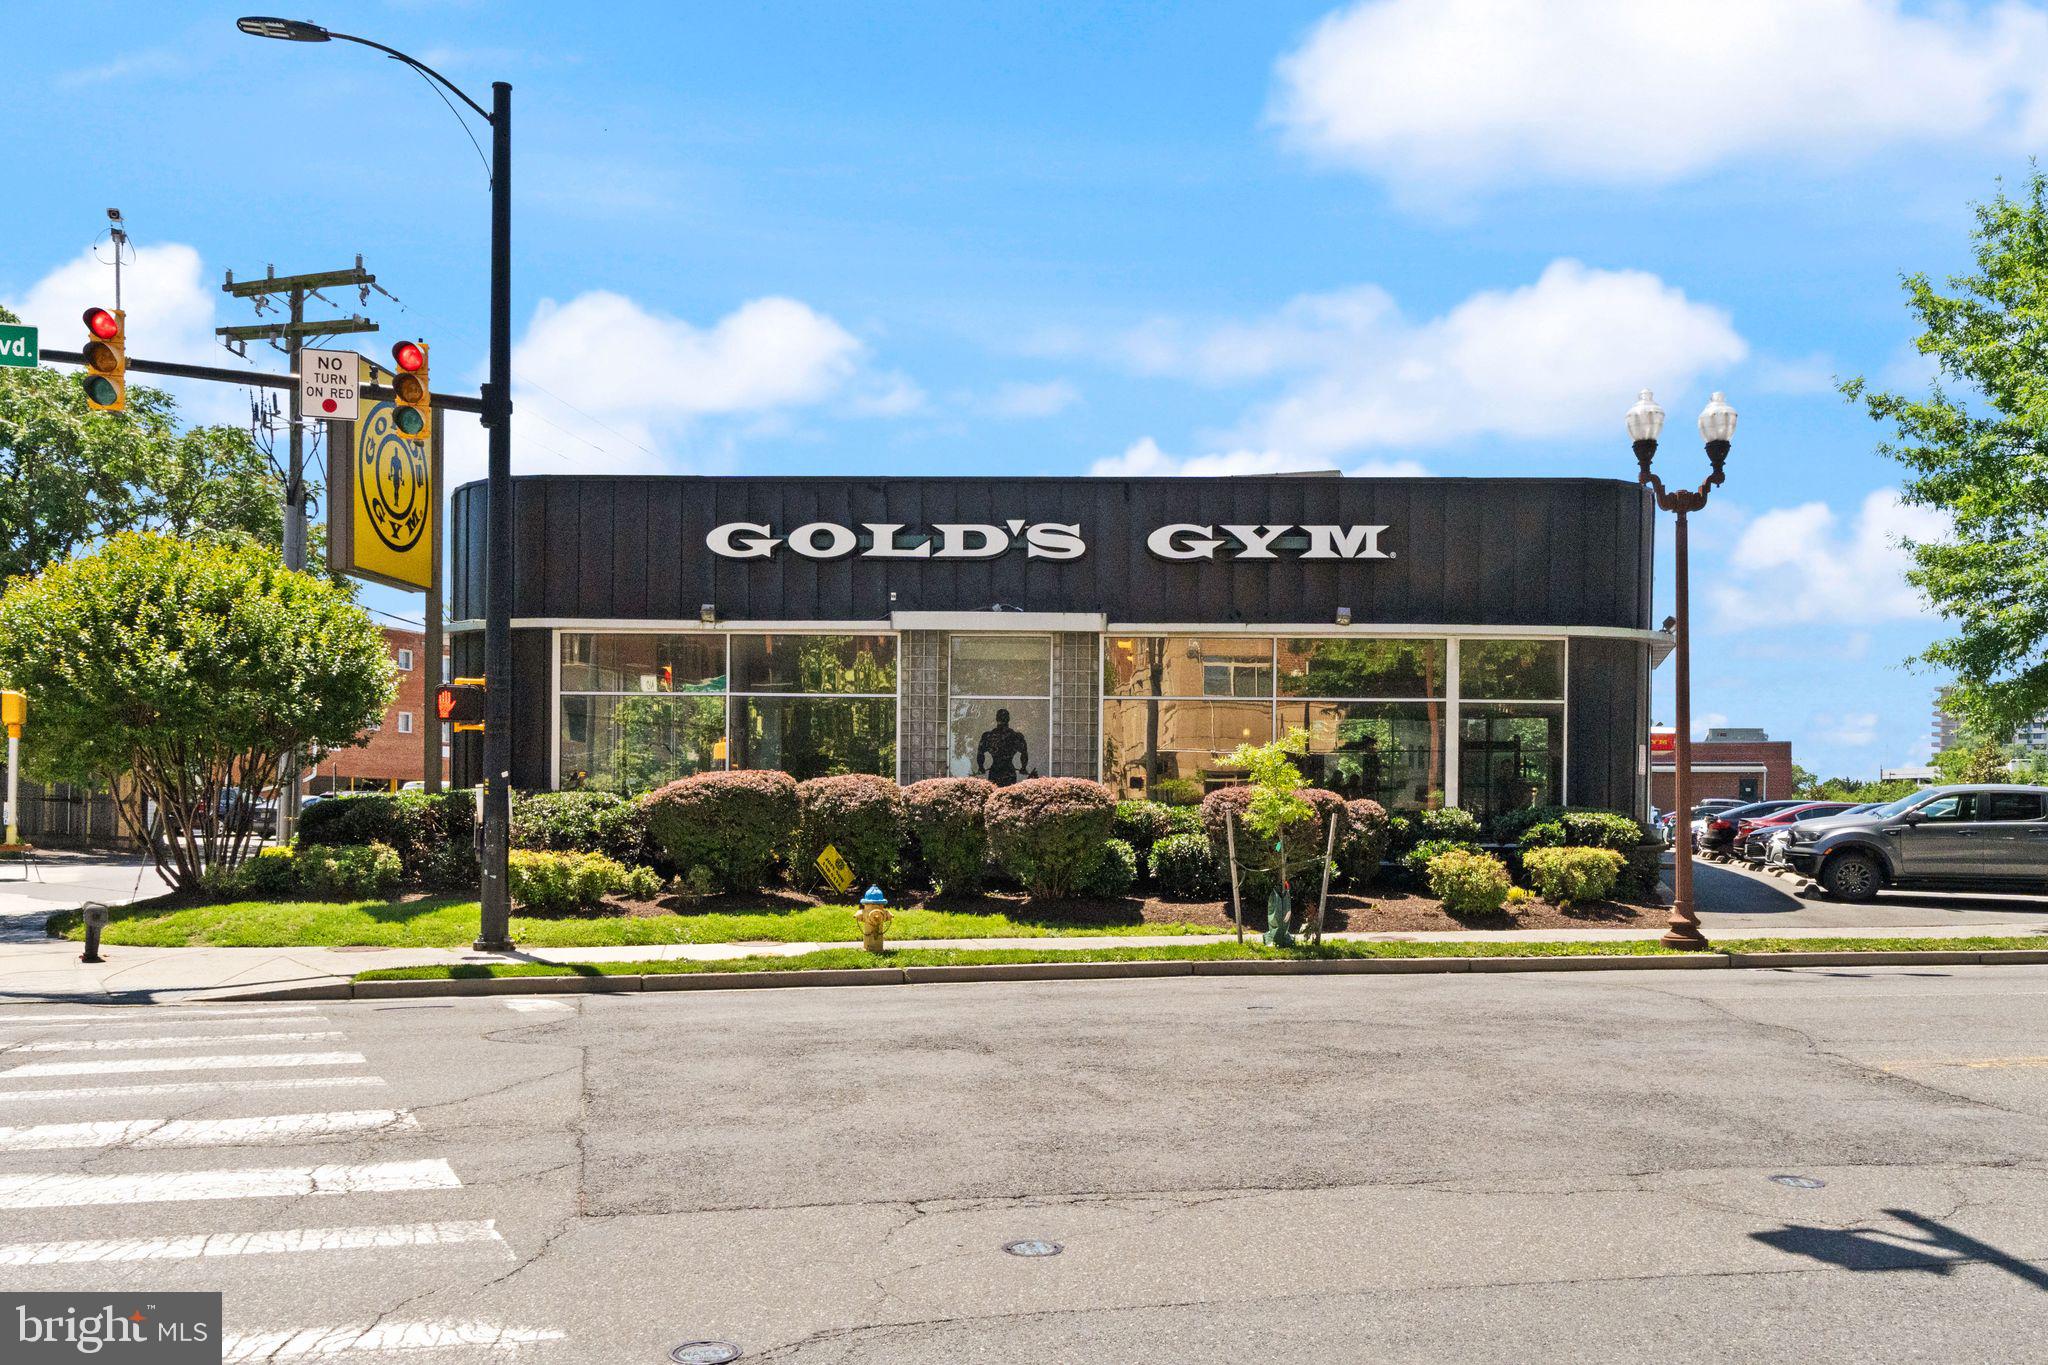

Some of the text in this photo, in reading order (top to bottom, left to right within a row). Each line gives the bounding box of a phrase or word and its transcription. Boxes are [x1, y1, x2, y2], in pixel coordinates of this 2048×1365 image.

[318, 356, 343, 371] NO
[314, 372, 347, 385] TURN
[306, 386, 354, 399] ON RED
[372, 497, 422, 541] GYM
[705, 519, 1087, 560] GOLD'S
